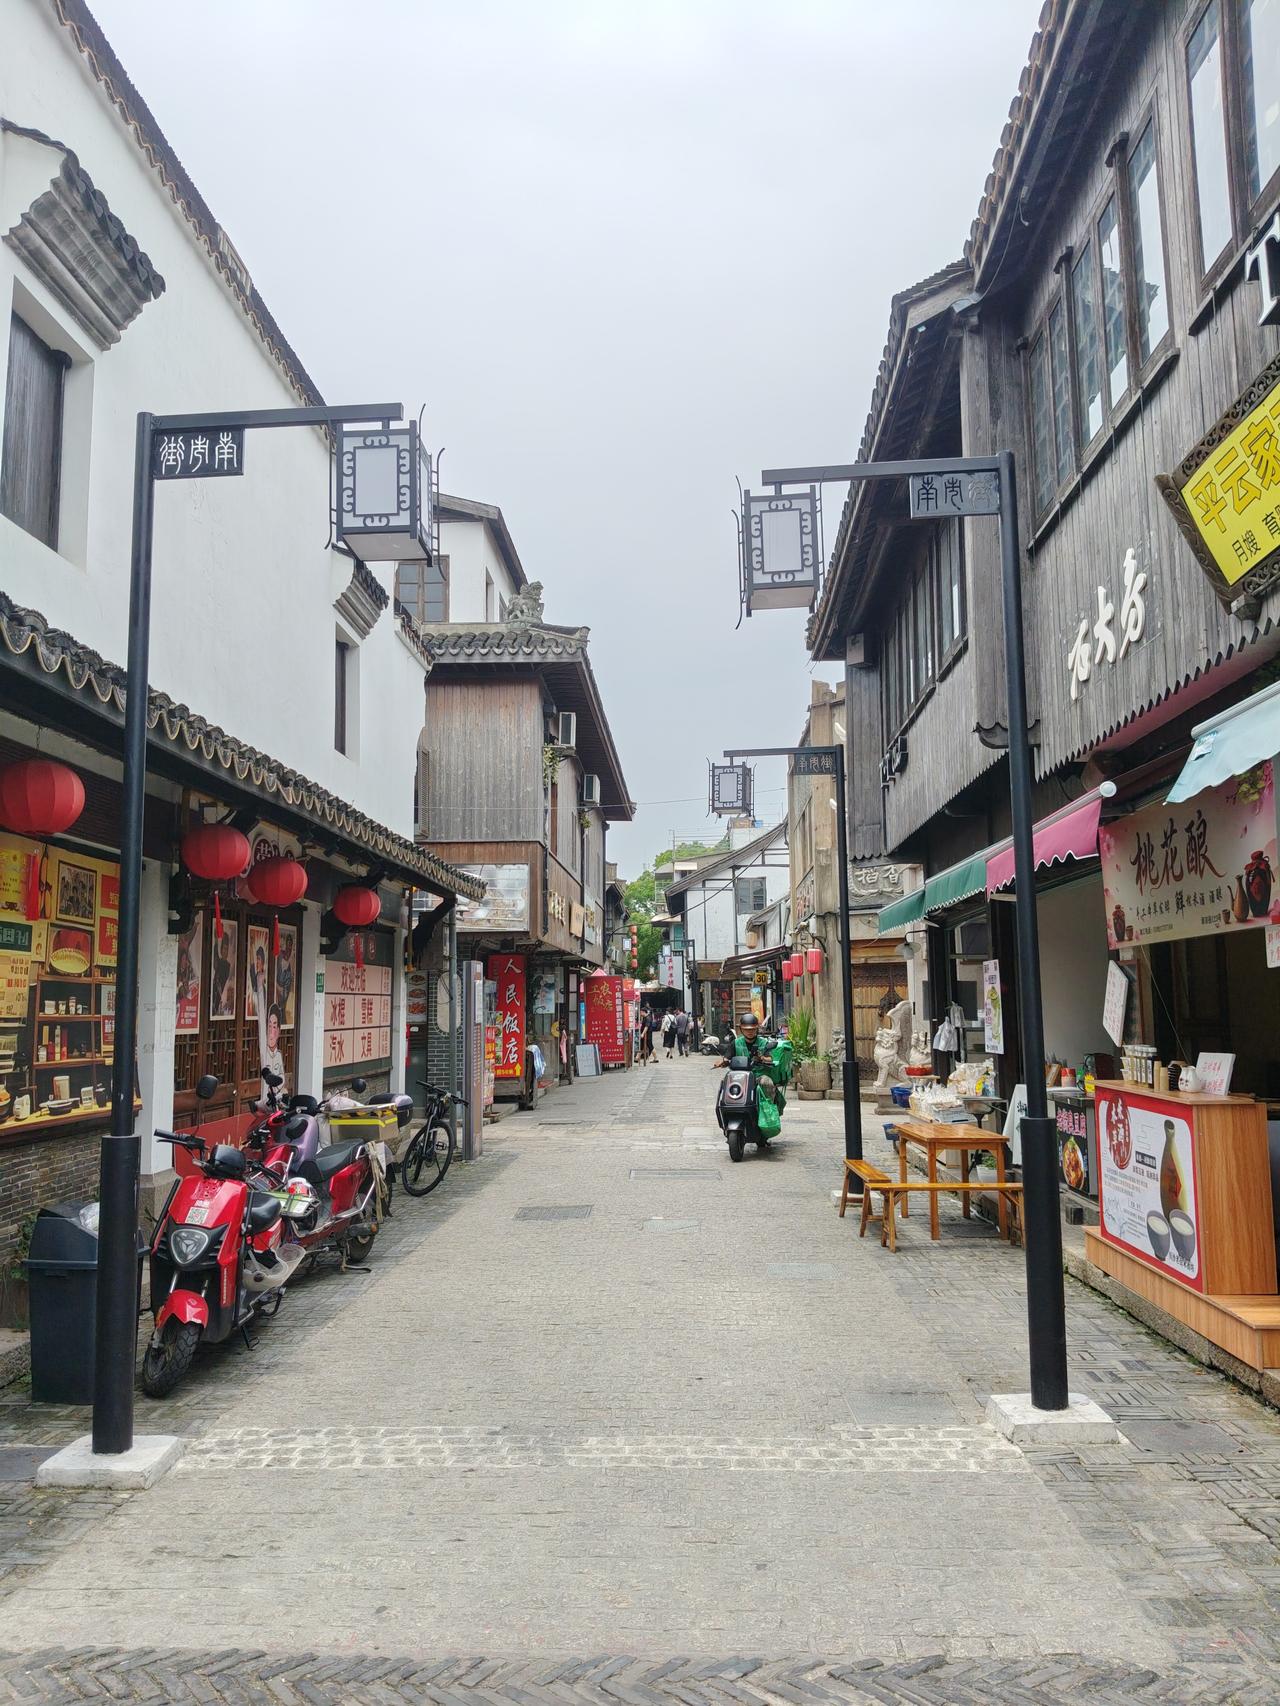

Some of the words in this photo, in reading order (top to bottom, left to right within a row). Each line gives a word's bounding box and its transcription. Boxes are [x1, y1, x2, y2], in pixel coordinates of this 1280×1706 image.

[1190, 403, 1280, 534] 平云家
[1212, 529, 1261, 566] 月嫂
[1129, 808, 1228, 897] 桃花酿
[756, 973, 767, 984] 30
[330, 997, 346, 1026] 冰棍
[361, 997, 374, 1025] 雪糕
[502, 958, 521, 1065] 人民饭店
[329, 1032, 345, 1063] 汽水
[361, 1031, 372, 1059] 文具
